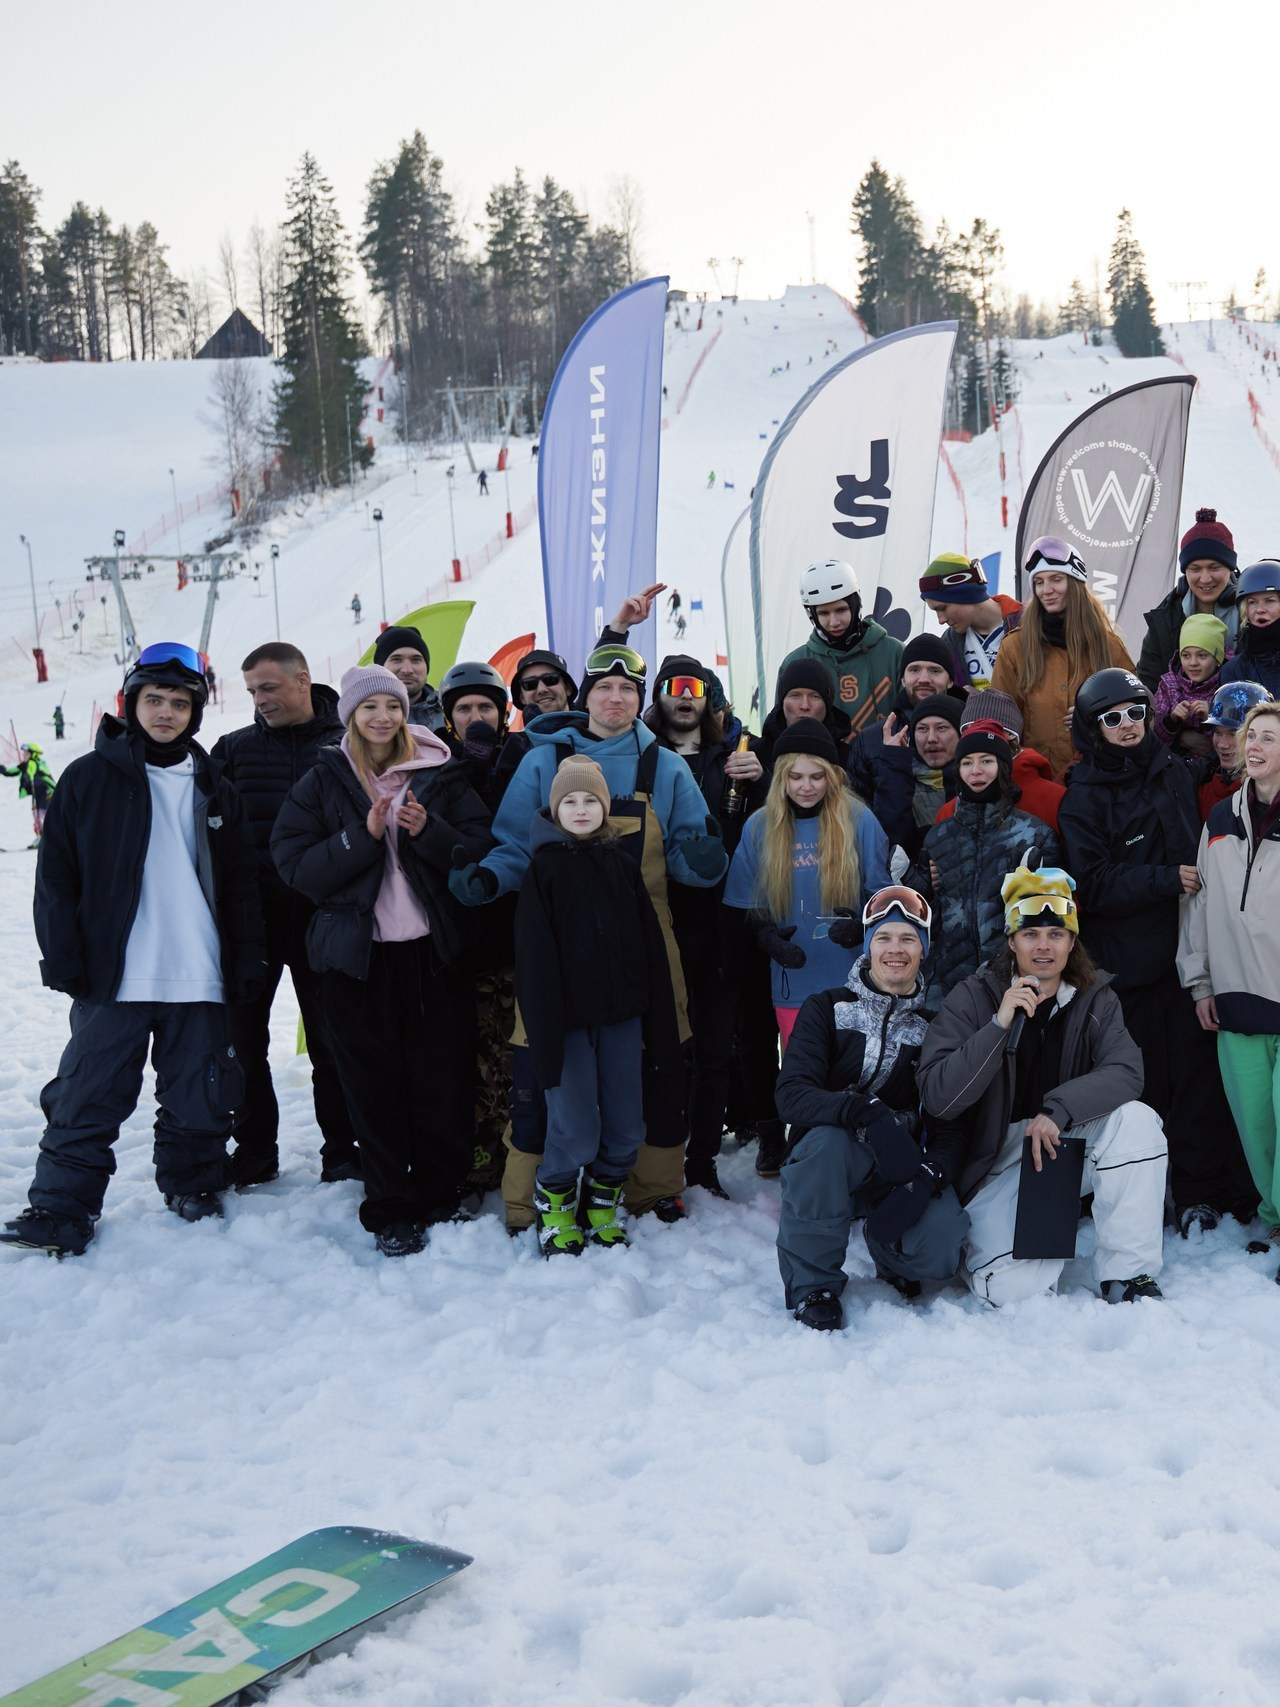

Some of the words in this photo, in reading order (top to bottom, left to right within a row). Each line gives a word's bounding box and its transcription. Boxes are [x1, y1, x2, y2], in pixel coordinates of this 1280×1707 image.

[1067, 440, 1106, 468] welcome
[1107, 439, 1138, 454] shape
[1138, 451, 1155, 473] crew
[590, 364, 607, 582] ЖИЗНИ
[1055, 468, 1068, 493] crew
[1055, 494, 1070, 525] shape
[1071, 523, 1108, 549] welcome
